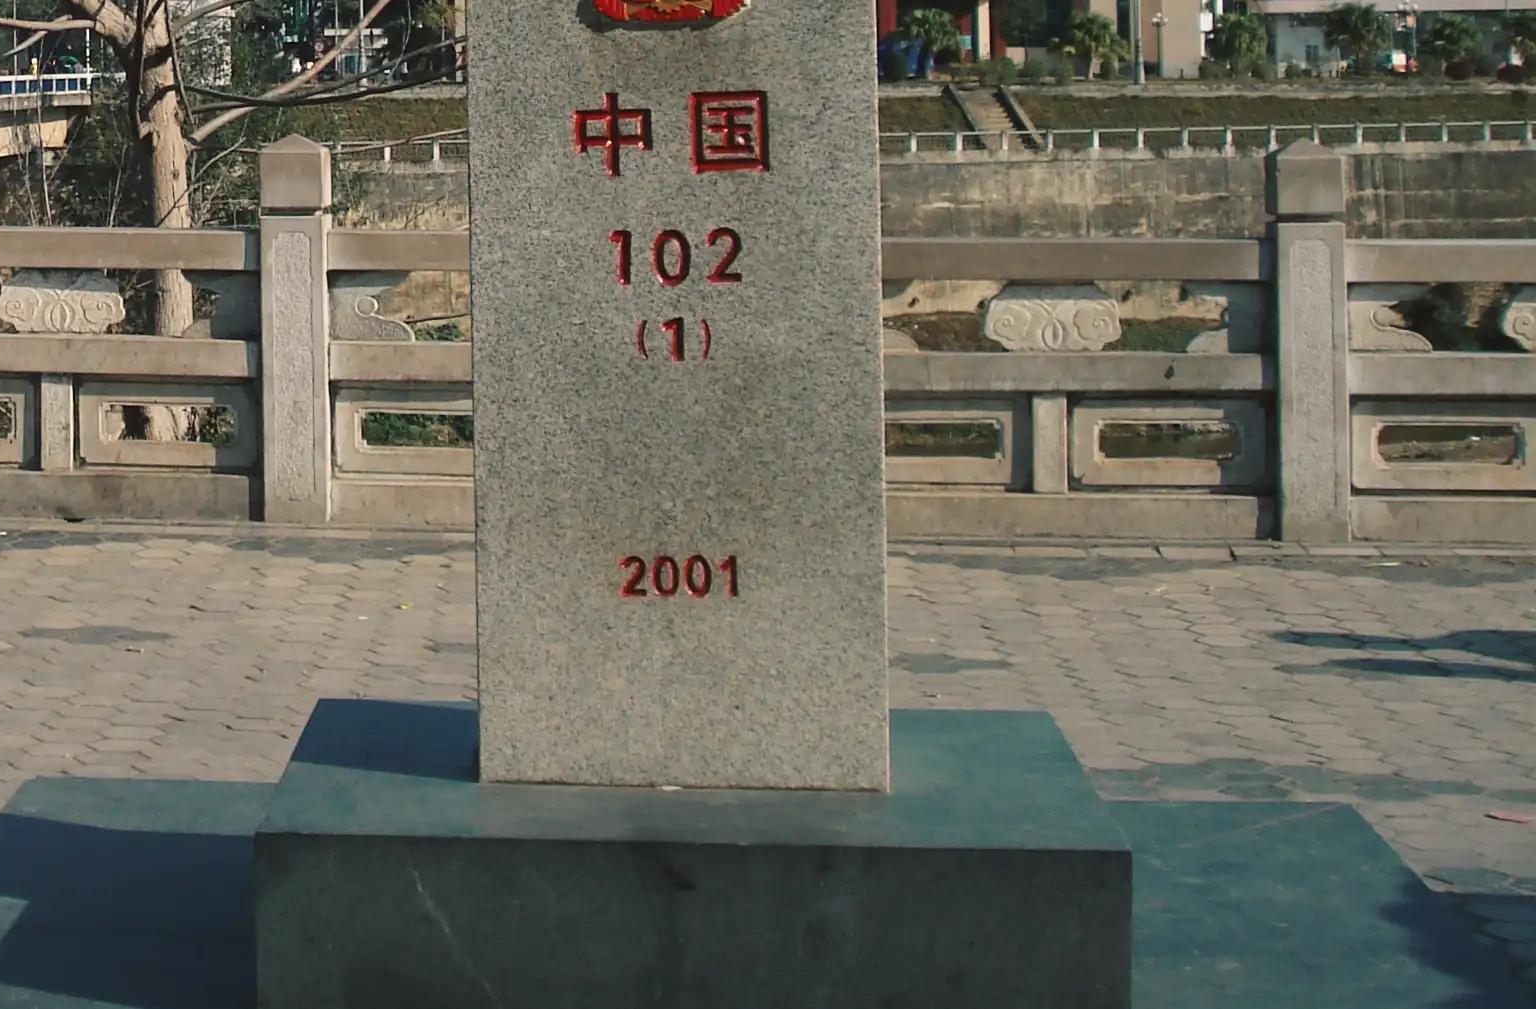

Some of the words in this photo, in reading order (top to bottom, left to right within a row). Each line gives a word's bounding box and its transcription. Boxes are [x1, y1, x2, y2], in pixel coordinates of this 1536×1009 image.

[572, 91, 769, 177] 中国
[607, 228, 743, 288] 102
[635, 317, 713, 363] (1)
[617, 554, 739, 599] 2001
